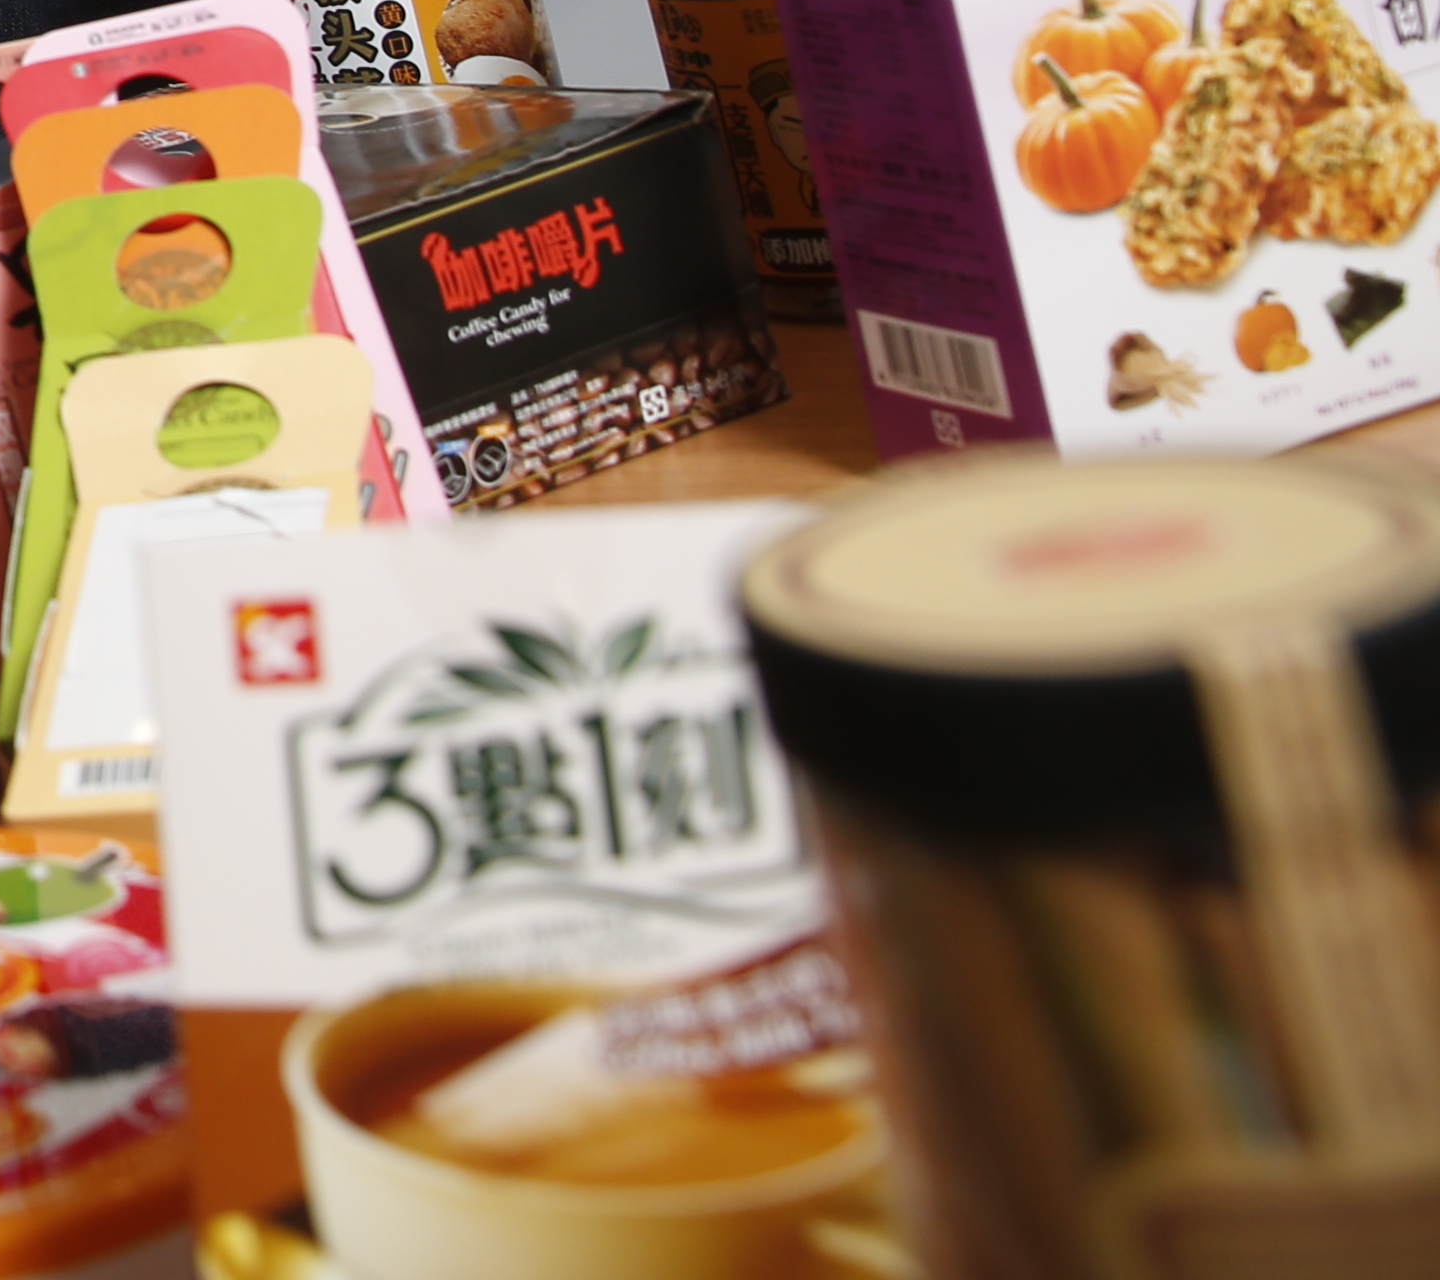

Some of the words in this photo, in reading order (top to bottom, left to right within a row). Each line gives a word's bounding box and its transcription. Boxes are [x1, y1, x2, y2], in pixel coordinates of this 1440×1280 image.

[421, 196, 625, 312] 咖啡嚼片
[447, 315, 498, 343] Coffee
[499, 296, 548, 324] Candy
[548, 288, 571, 307] for
[485, 315, 550, 347] chewing
[322, 700, 760, 908] 3點1刻
